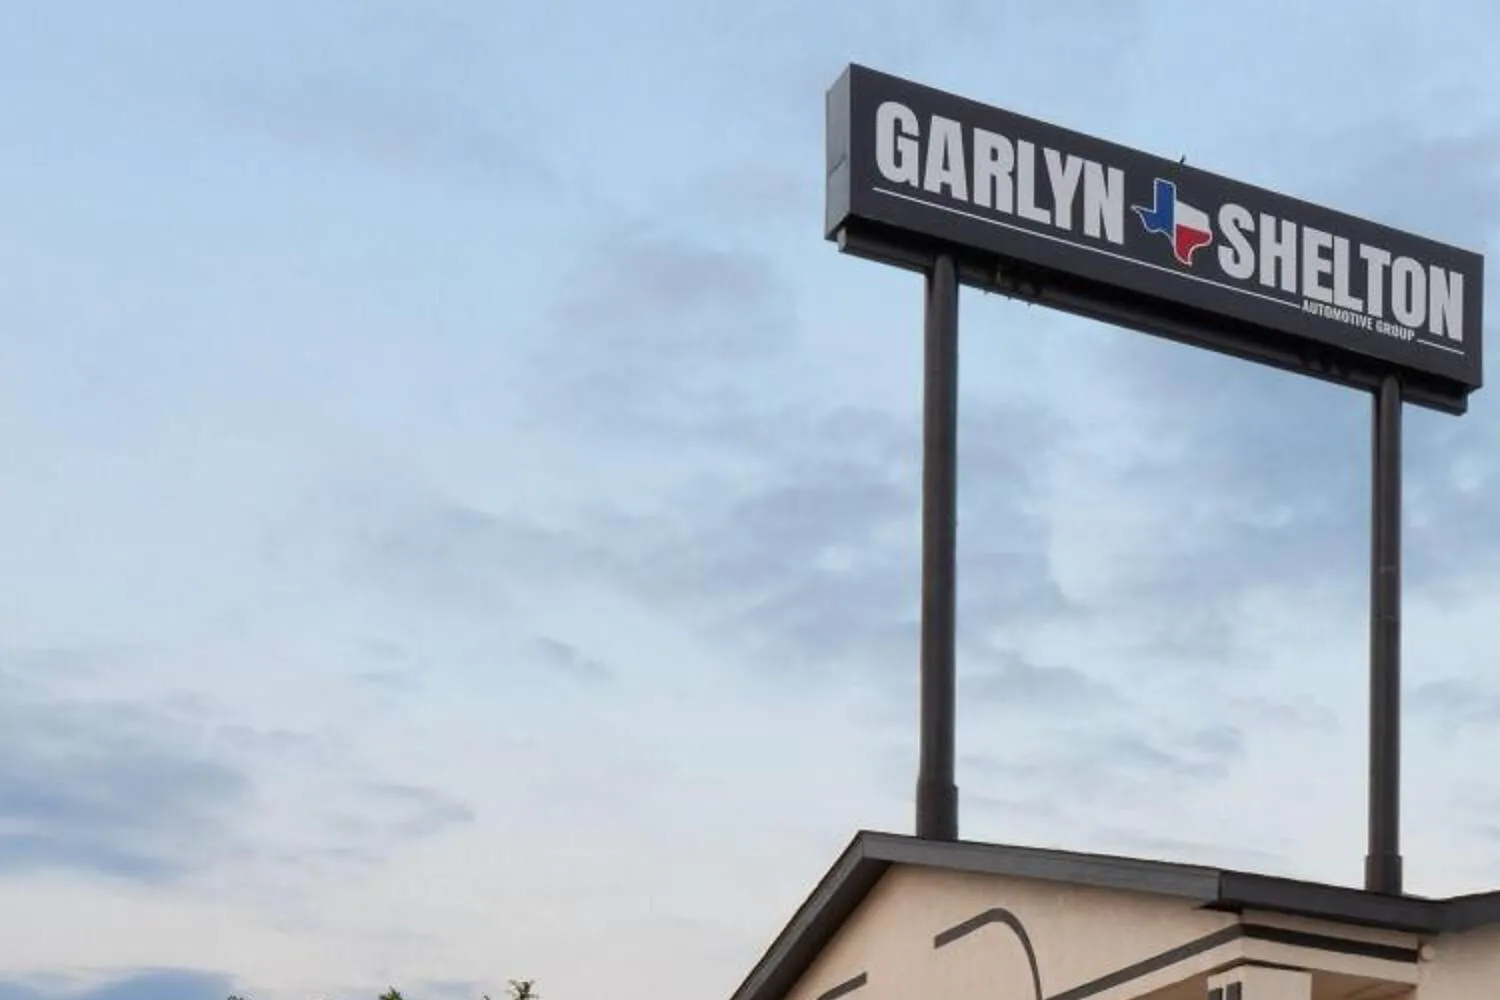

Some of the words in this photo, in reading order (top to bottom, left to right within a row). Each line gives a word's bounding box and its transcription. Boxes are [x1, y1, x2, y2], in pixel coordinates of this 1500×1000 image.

[876, 101, 1124, 245] GARLYN
[1217, 203, 1464, 342] SHELTON
[1302, 299, 1373, 331] AUTOMOTIVE
[1375, 320, 1415, 341] GROUP
